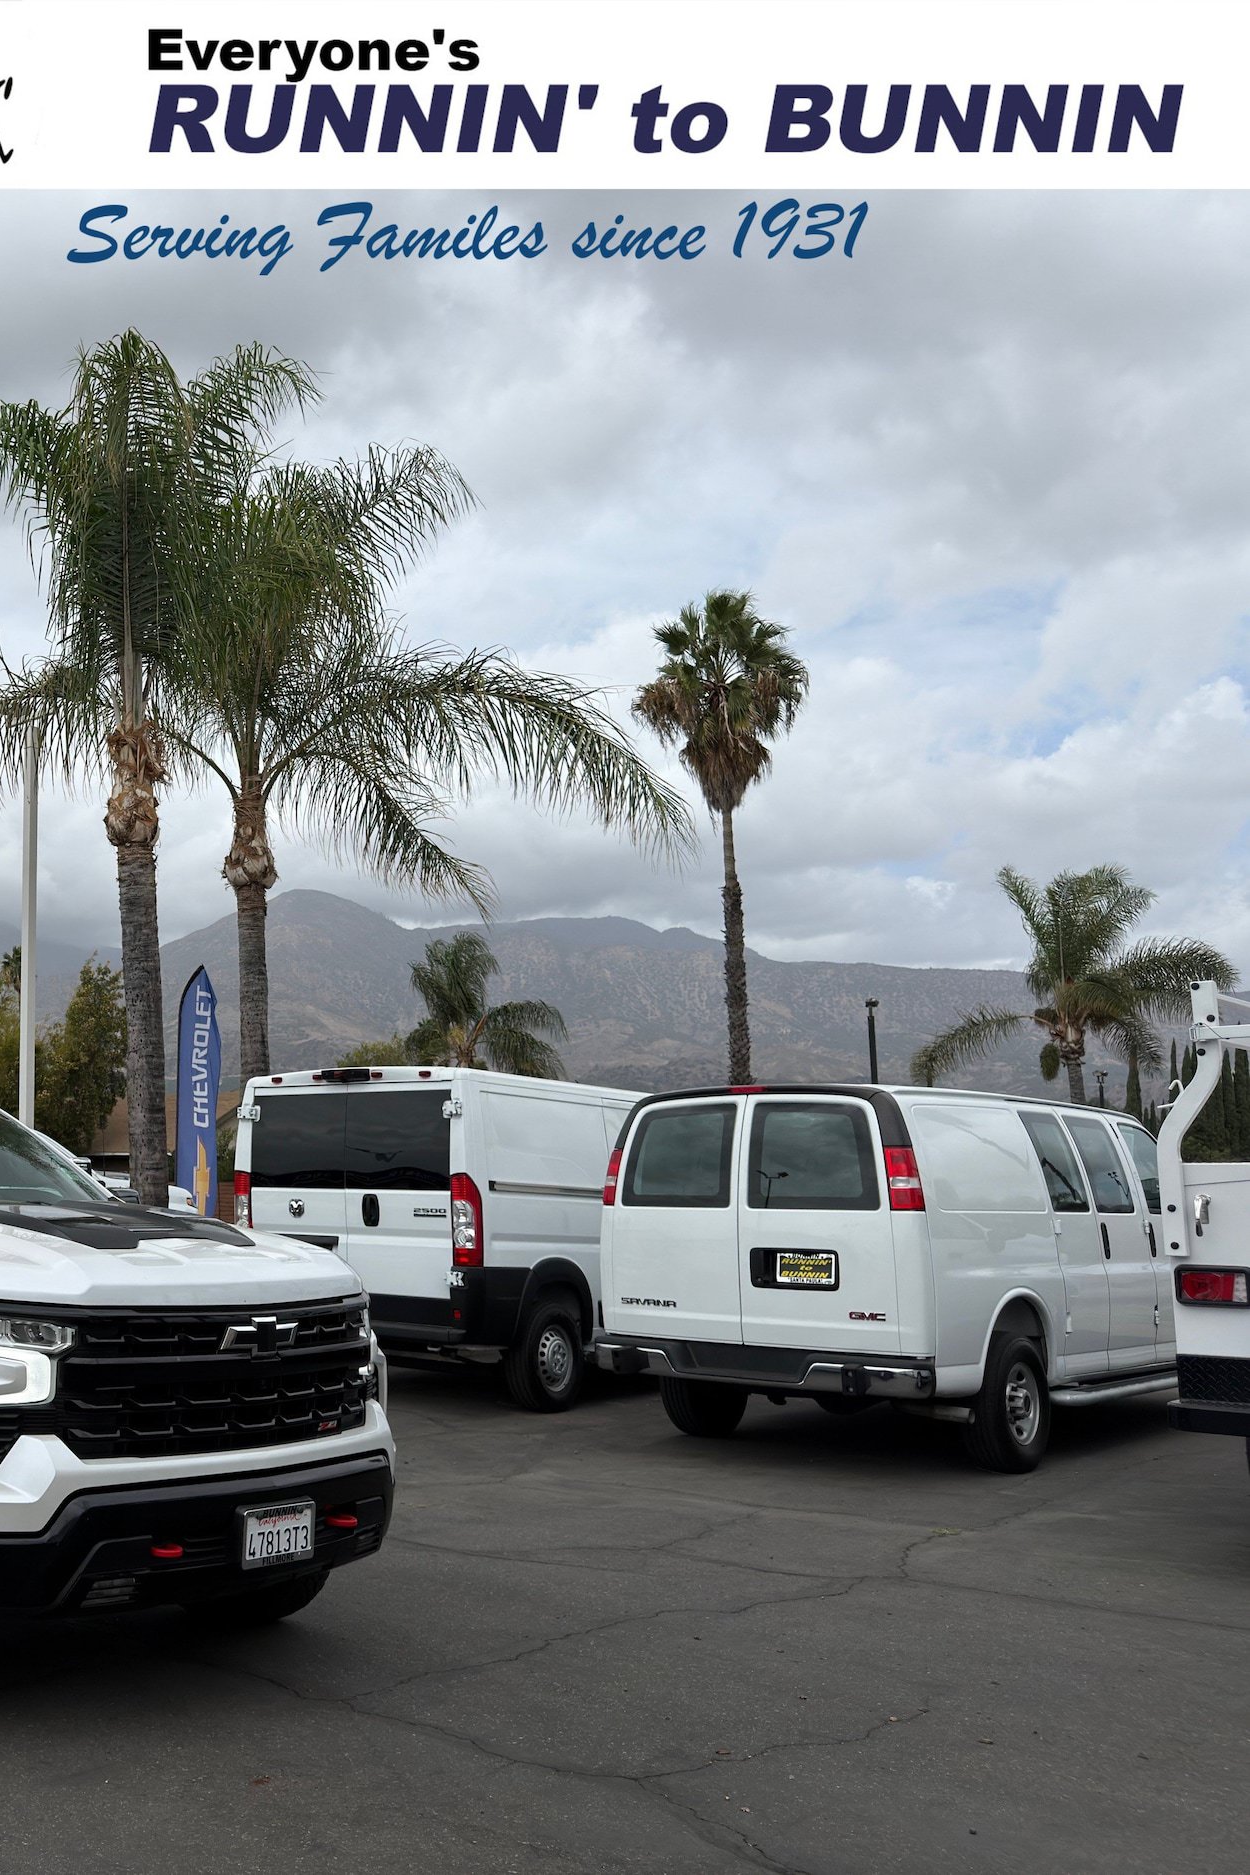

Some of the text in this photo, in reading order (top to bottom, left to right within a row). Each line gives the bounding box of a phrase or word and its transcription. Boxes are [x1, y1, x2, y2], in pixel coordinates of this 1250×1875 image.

[191, 985, 212, 1129] CHEVROLET
[781, 1270, 829, 1278] BUNNIN
[621, 1297, 677, 1308] SAVANA
[849, 1312, 886, 1321] GMC
[249, 1525, 309, 1558] 47813T3
[262, 1552, 295, 1566] FILLMORE
